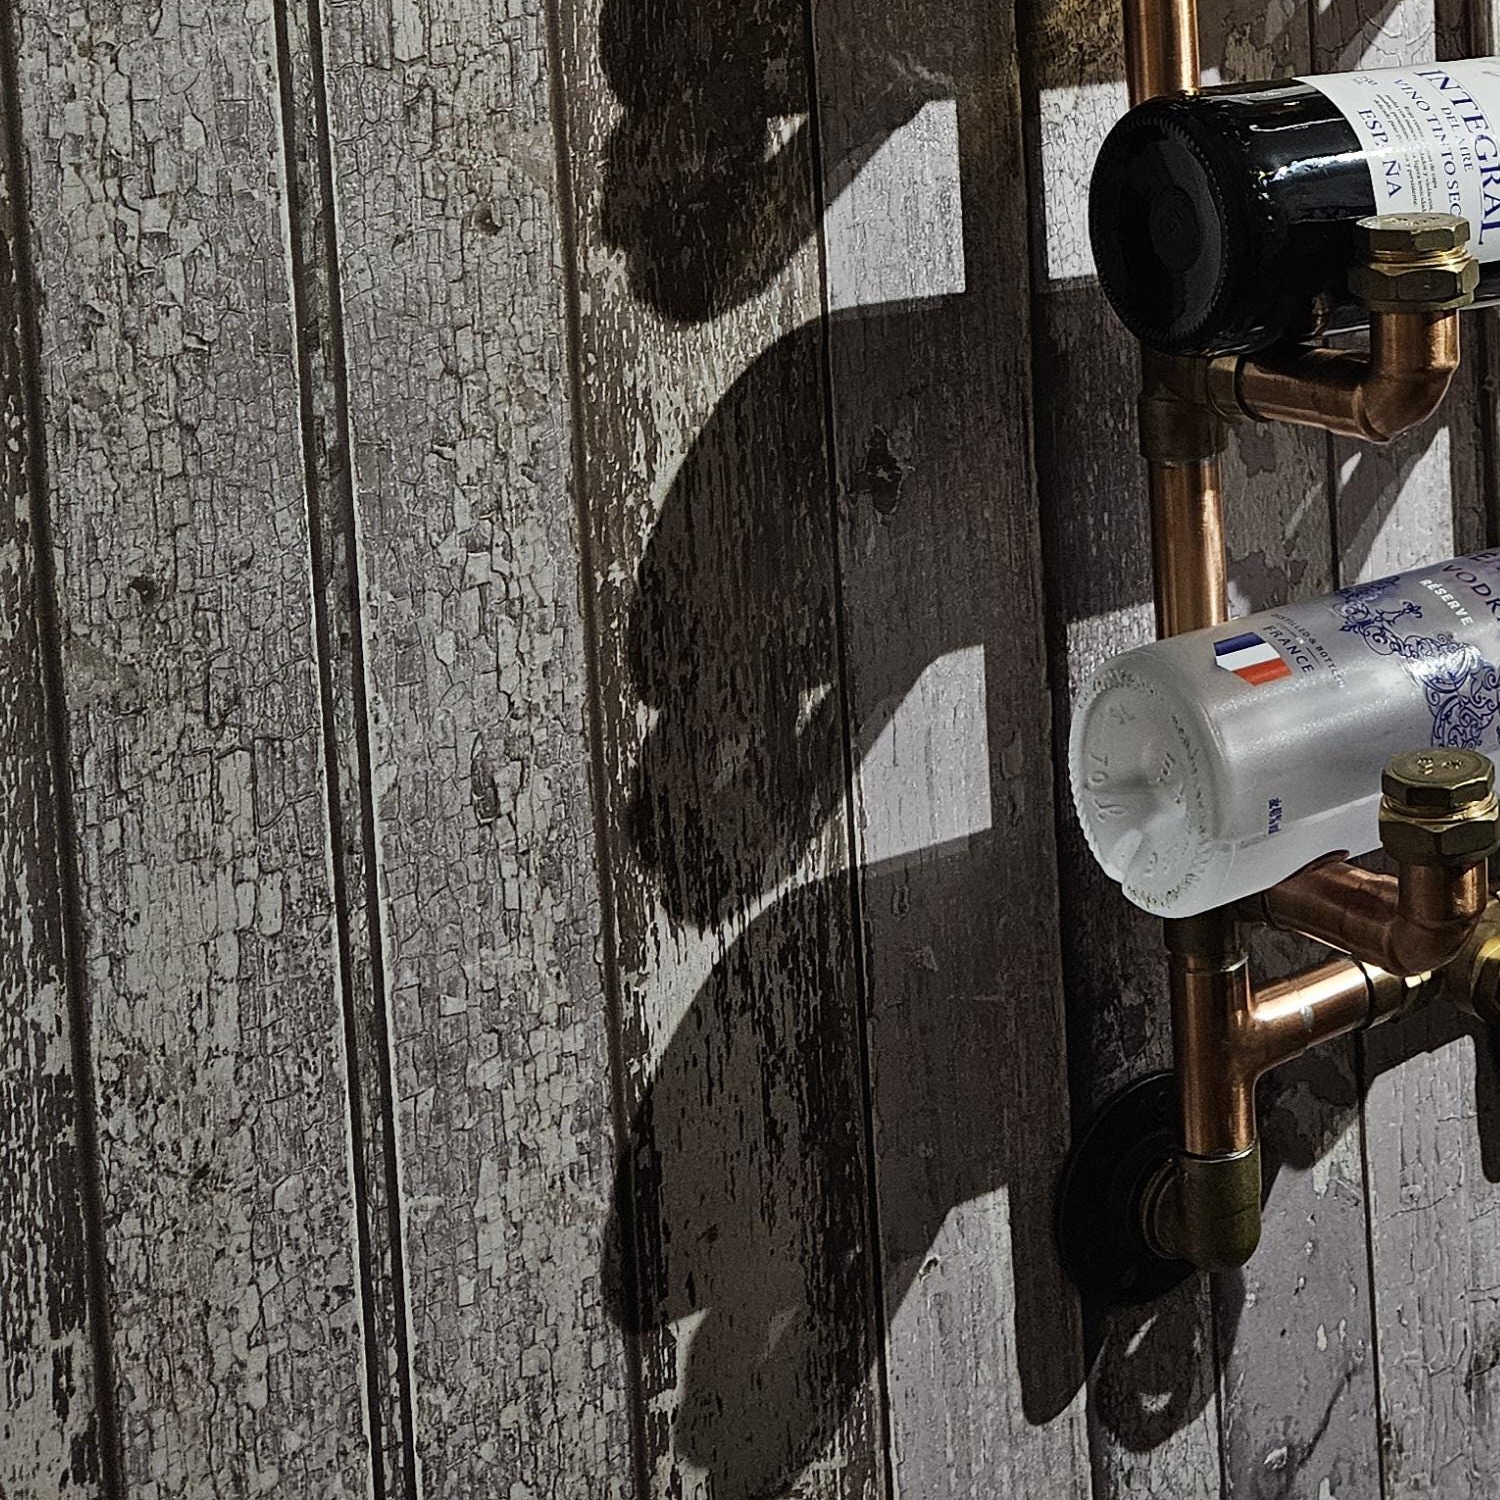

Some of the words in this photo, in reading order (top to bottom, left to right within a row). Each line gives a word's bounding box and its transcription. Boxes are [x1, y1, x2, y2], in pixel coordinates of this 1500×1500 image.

[1441, 106, 1460, 132] DEL
[1356, 109, 1403, 199] ESPÑA
[1394, 78, 1431, 112] VINO
[1426, 112, 1456, 176] TINTO
[1446, 179, 1462, 218] SEC
[1419, 579, 1474, 627] RÉSERVE
[1262, 624, 1315, 674] FRANCE
